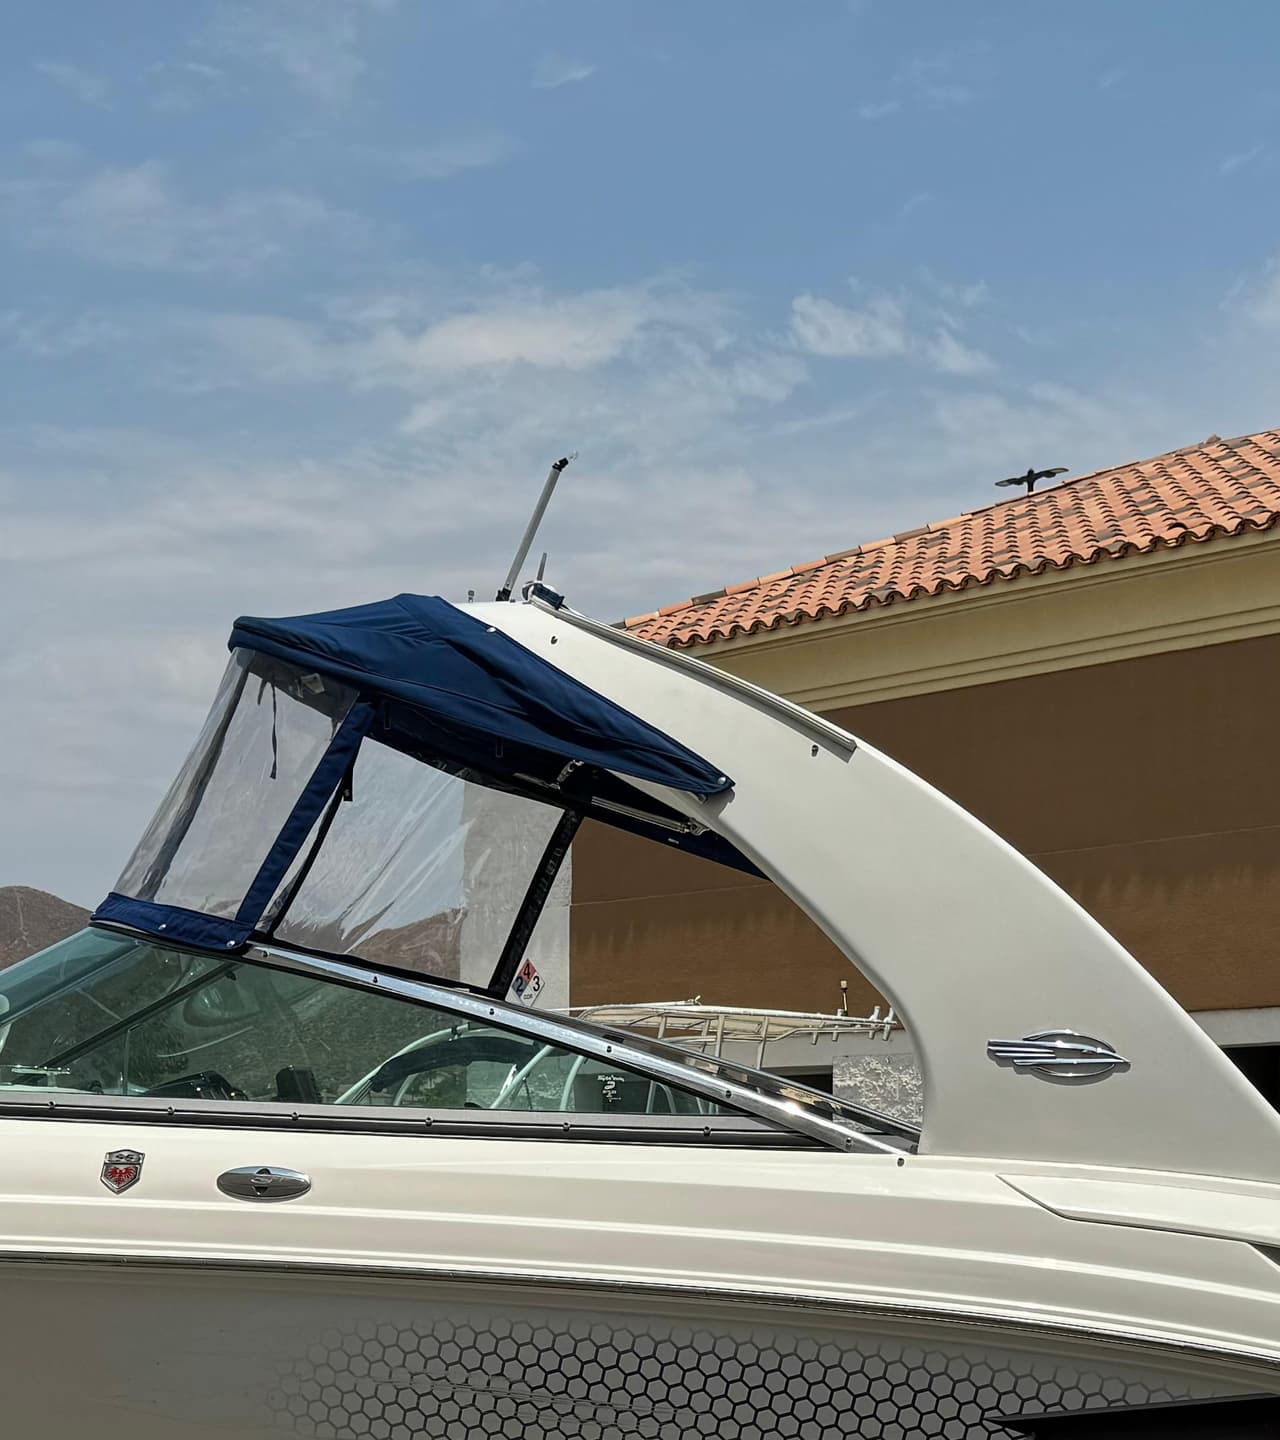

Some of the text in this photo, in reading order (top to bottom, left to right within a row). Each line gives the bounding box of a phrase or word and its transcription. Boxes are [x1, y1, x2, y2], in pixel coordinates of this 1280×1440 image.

[523, 962, 531, 979] 4
[515, 976, 524, 993] 2
[532, 975, 540, 992] 3
